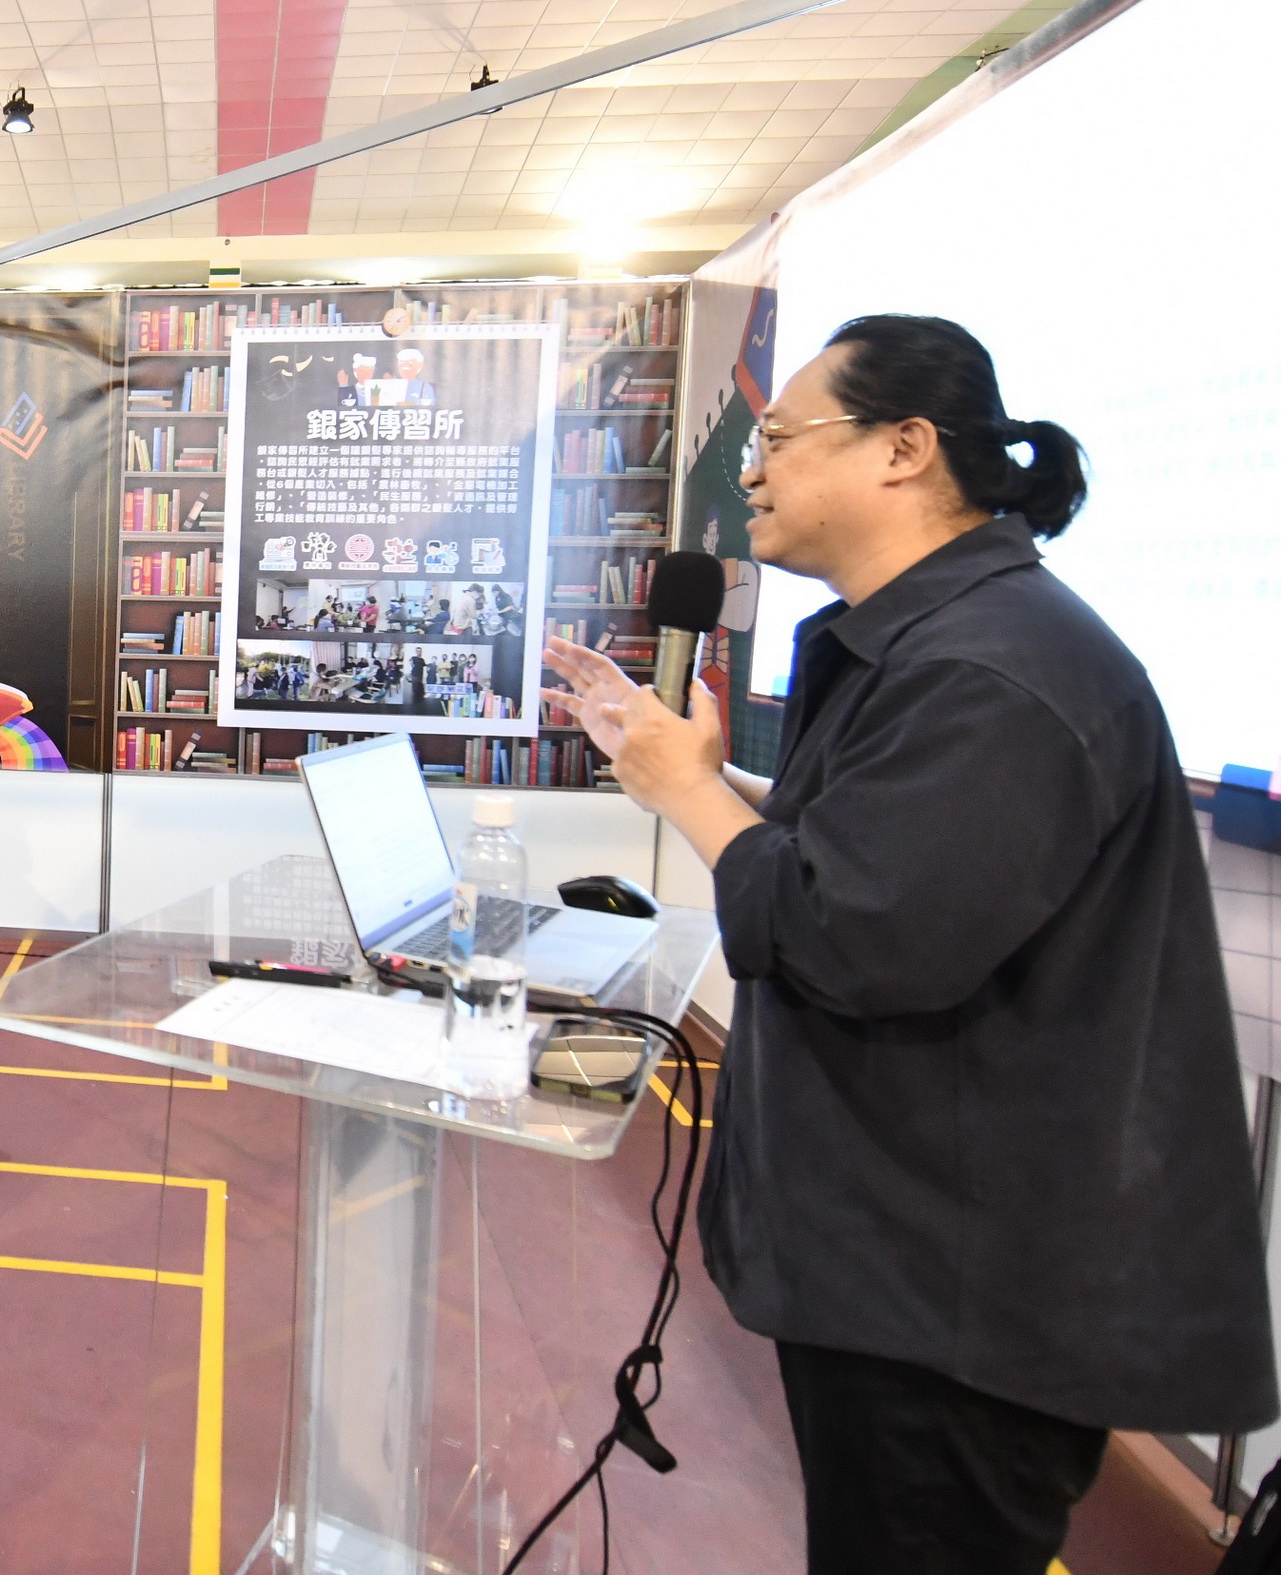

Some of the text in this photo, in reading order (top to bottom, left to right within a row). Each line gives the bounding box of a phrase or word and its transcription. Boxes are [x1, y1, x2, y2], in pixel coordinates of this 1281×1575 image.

[306, 409, 464, 440] 銀家傳習所
[8, 462, 26, 562] LIBRARY
